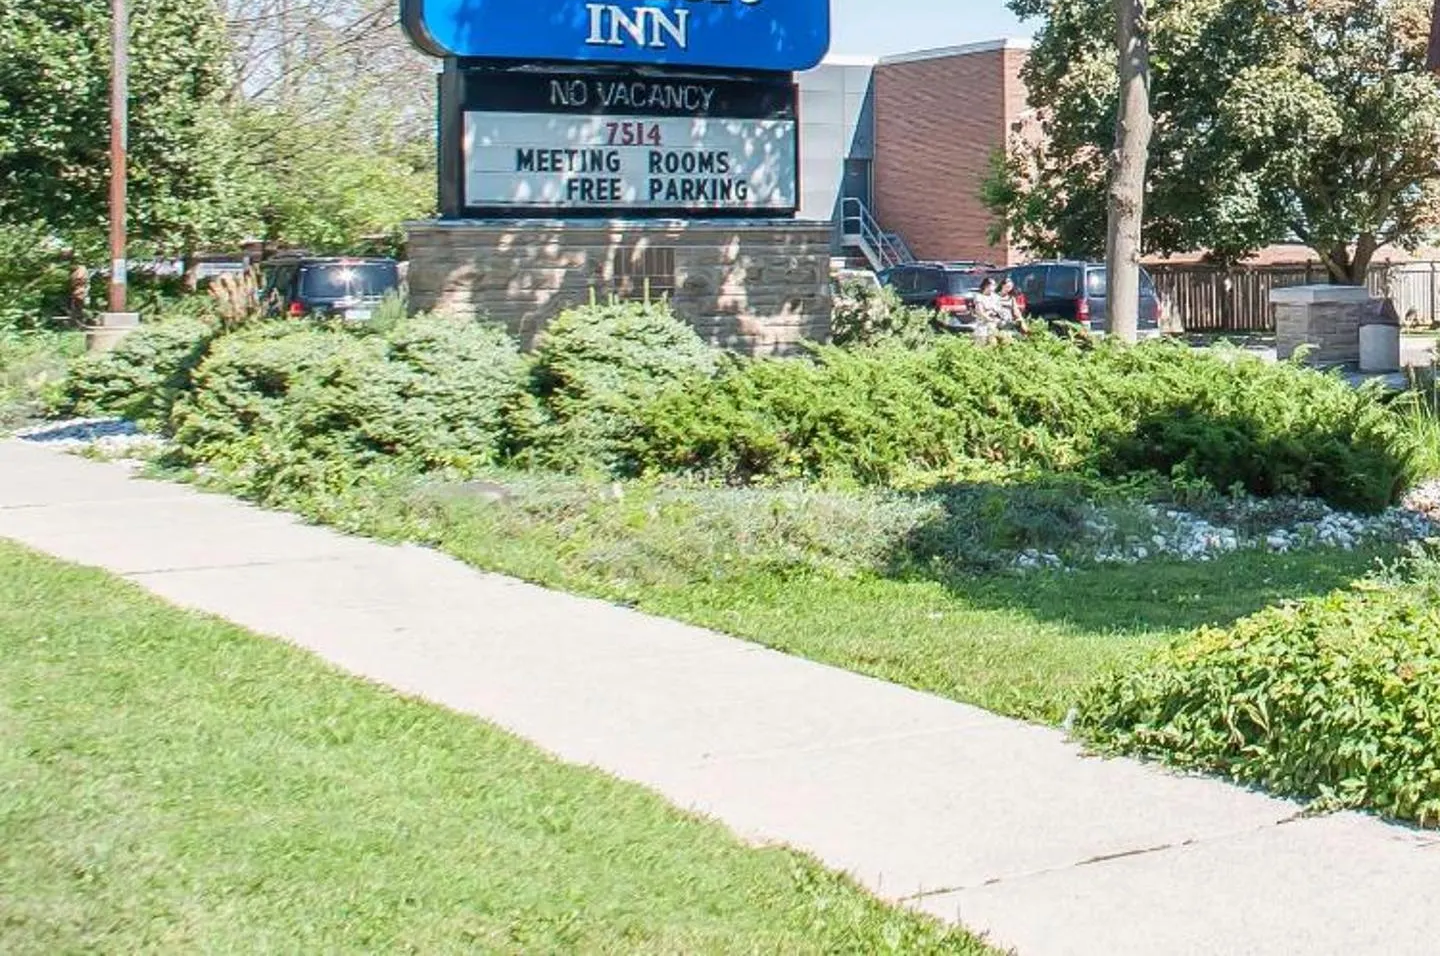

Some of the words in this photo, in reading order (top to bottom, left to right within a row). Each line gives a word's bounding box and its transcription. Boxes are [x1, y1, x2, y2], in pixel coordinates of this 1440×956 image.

[585, 3, 690, 49] INN
[550, 79, 587, 107] NO
[596, 81, 716, 110] VACANCY
[606, 122, 662, 146] 7514
[515, 148, 621, 172] MEETING
[649, 150, 730, 174] ROOMS
[566, 177, 622, 201] FREE
[649, 178, 748, 202] PARKING
